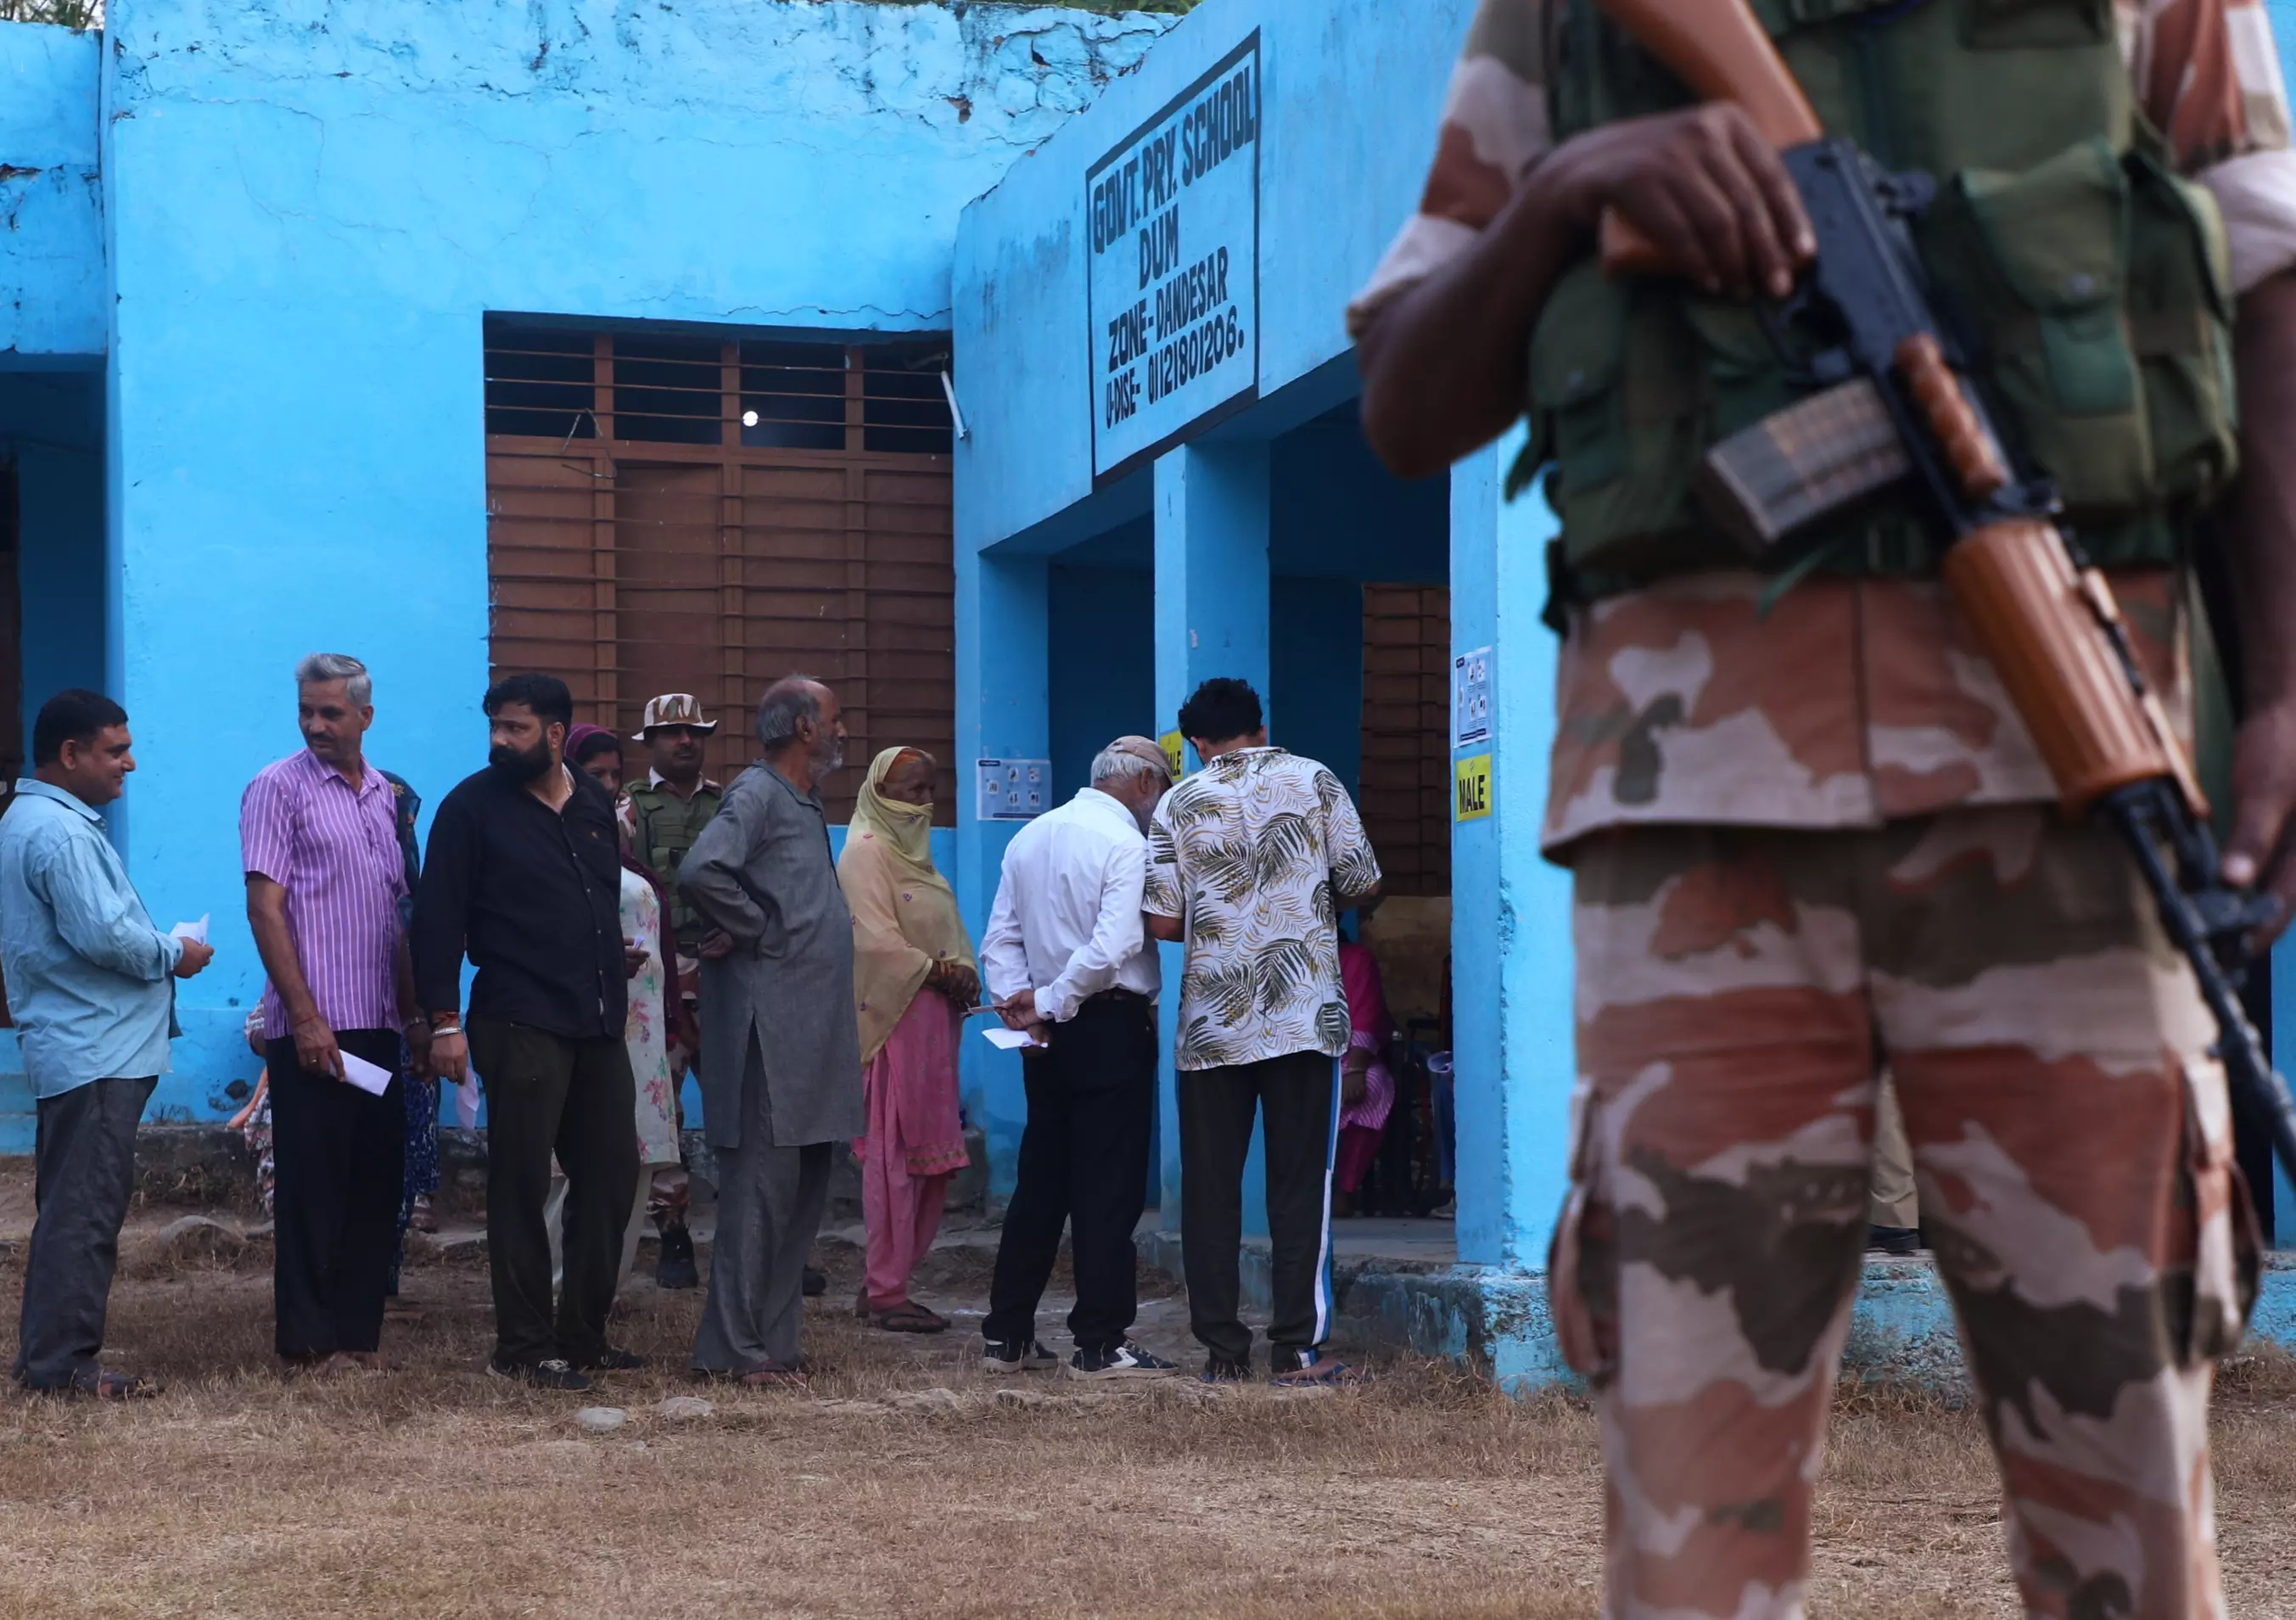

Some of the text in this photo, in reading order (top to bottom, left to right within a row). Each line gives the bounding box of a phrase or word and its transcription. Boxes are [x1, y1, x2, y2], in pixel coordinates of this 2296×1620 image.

[1094, 65, 1254, 253] GOVT. PRY. SCHOOL
[1139, 204, 1179, 290] DUM
[1459, 774, 1485, 815] MALE
